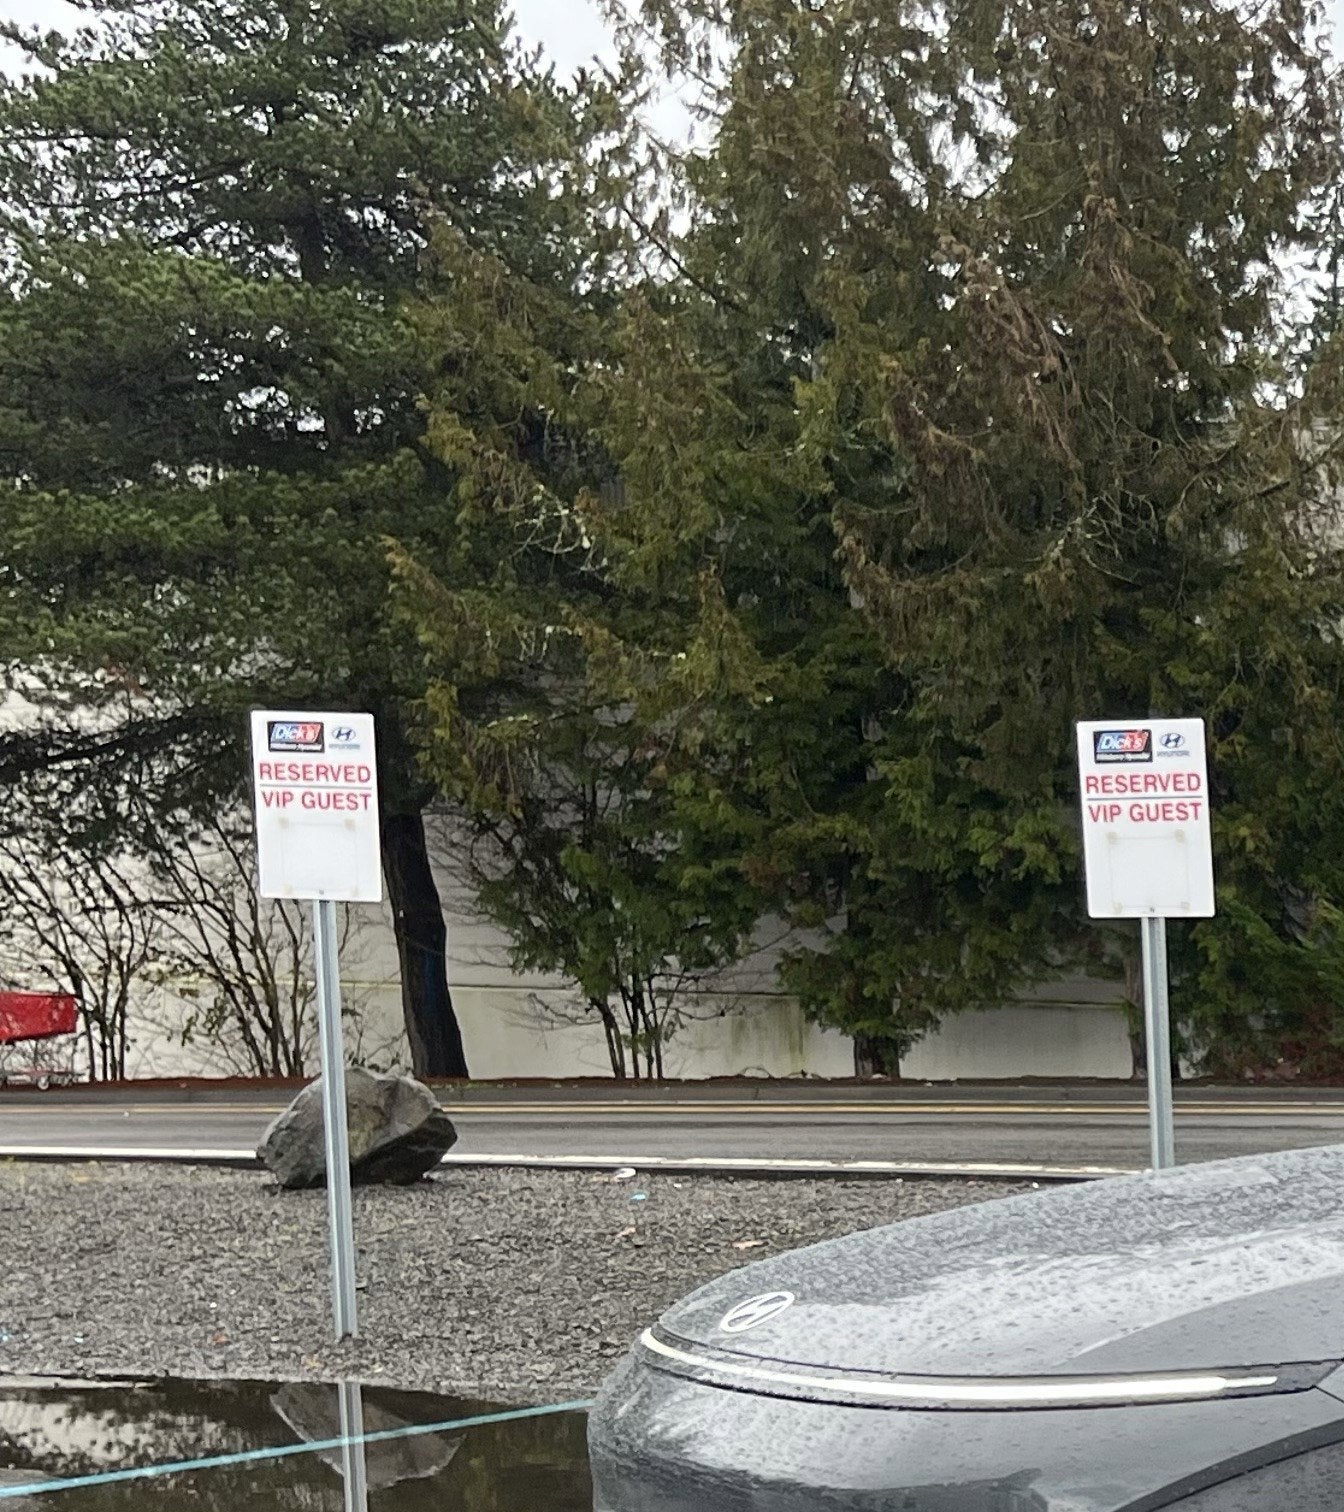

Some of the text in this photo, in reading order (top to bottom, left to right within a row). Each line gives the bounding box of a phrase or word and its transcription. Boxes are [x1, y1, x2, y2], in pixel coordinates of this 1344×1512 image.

[259, 763, 371, 783] RESERVED
[1085, 773, 1201, 795] RESERVED
[261, 790, 372, 811] VIP GUEST
[1088, 803, 1202, 823] VIP GUEST
